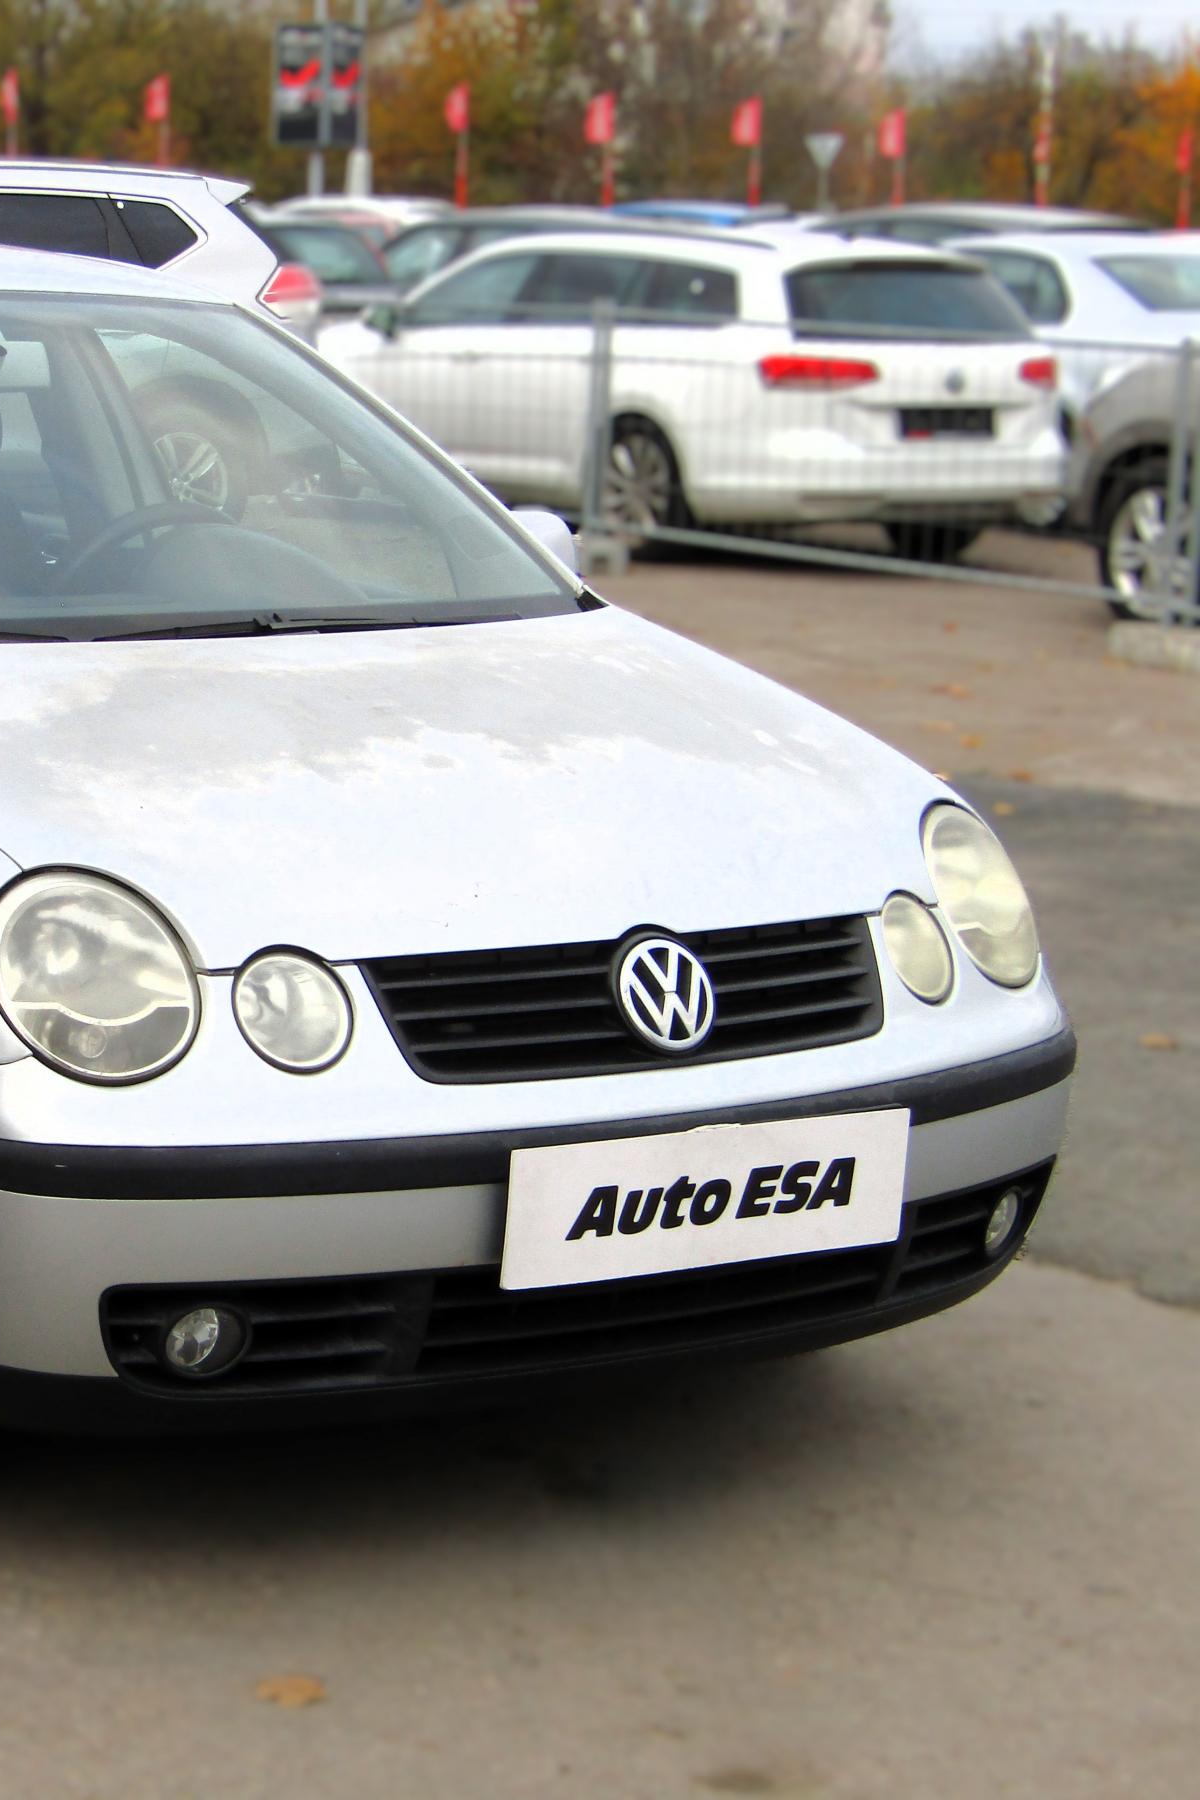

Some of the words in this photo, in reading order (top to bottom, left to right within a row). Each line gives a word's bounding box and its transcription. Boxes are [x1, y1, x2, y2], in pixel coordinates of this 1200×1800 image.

[620, 939, 714, 1049] VW
[565, 1175, 731, 1241] Auto
[735, 1156, 856, 1219] ESA
